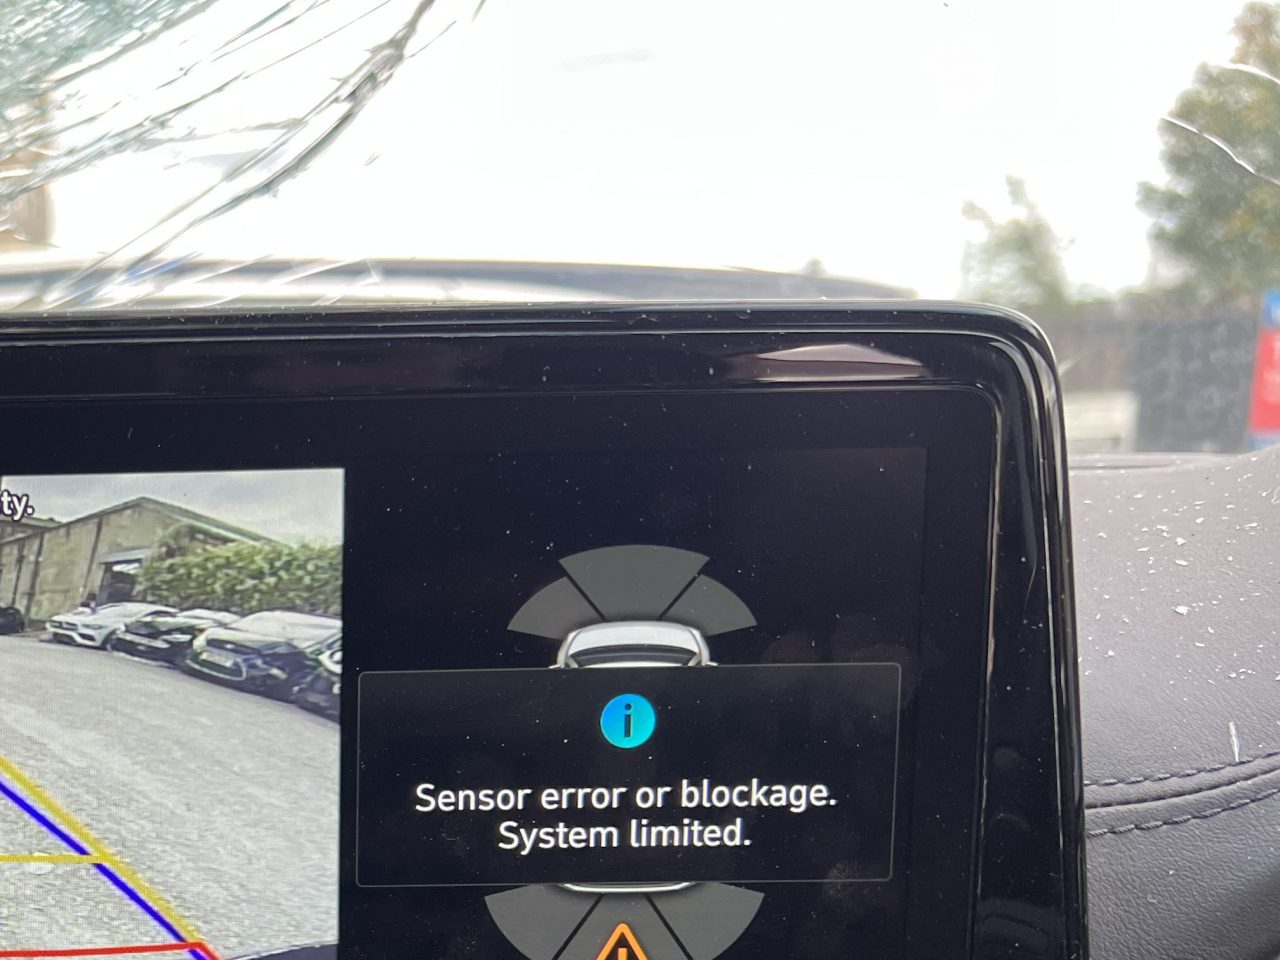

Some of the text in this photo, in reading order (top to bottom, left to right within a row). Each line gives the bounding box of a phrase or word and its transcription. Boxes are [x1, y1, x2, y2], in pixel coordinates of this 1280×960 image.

[416, 778, 836, 812] Sensor error or blockage.
[499, 818, 751, 855] System limited.
